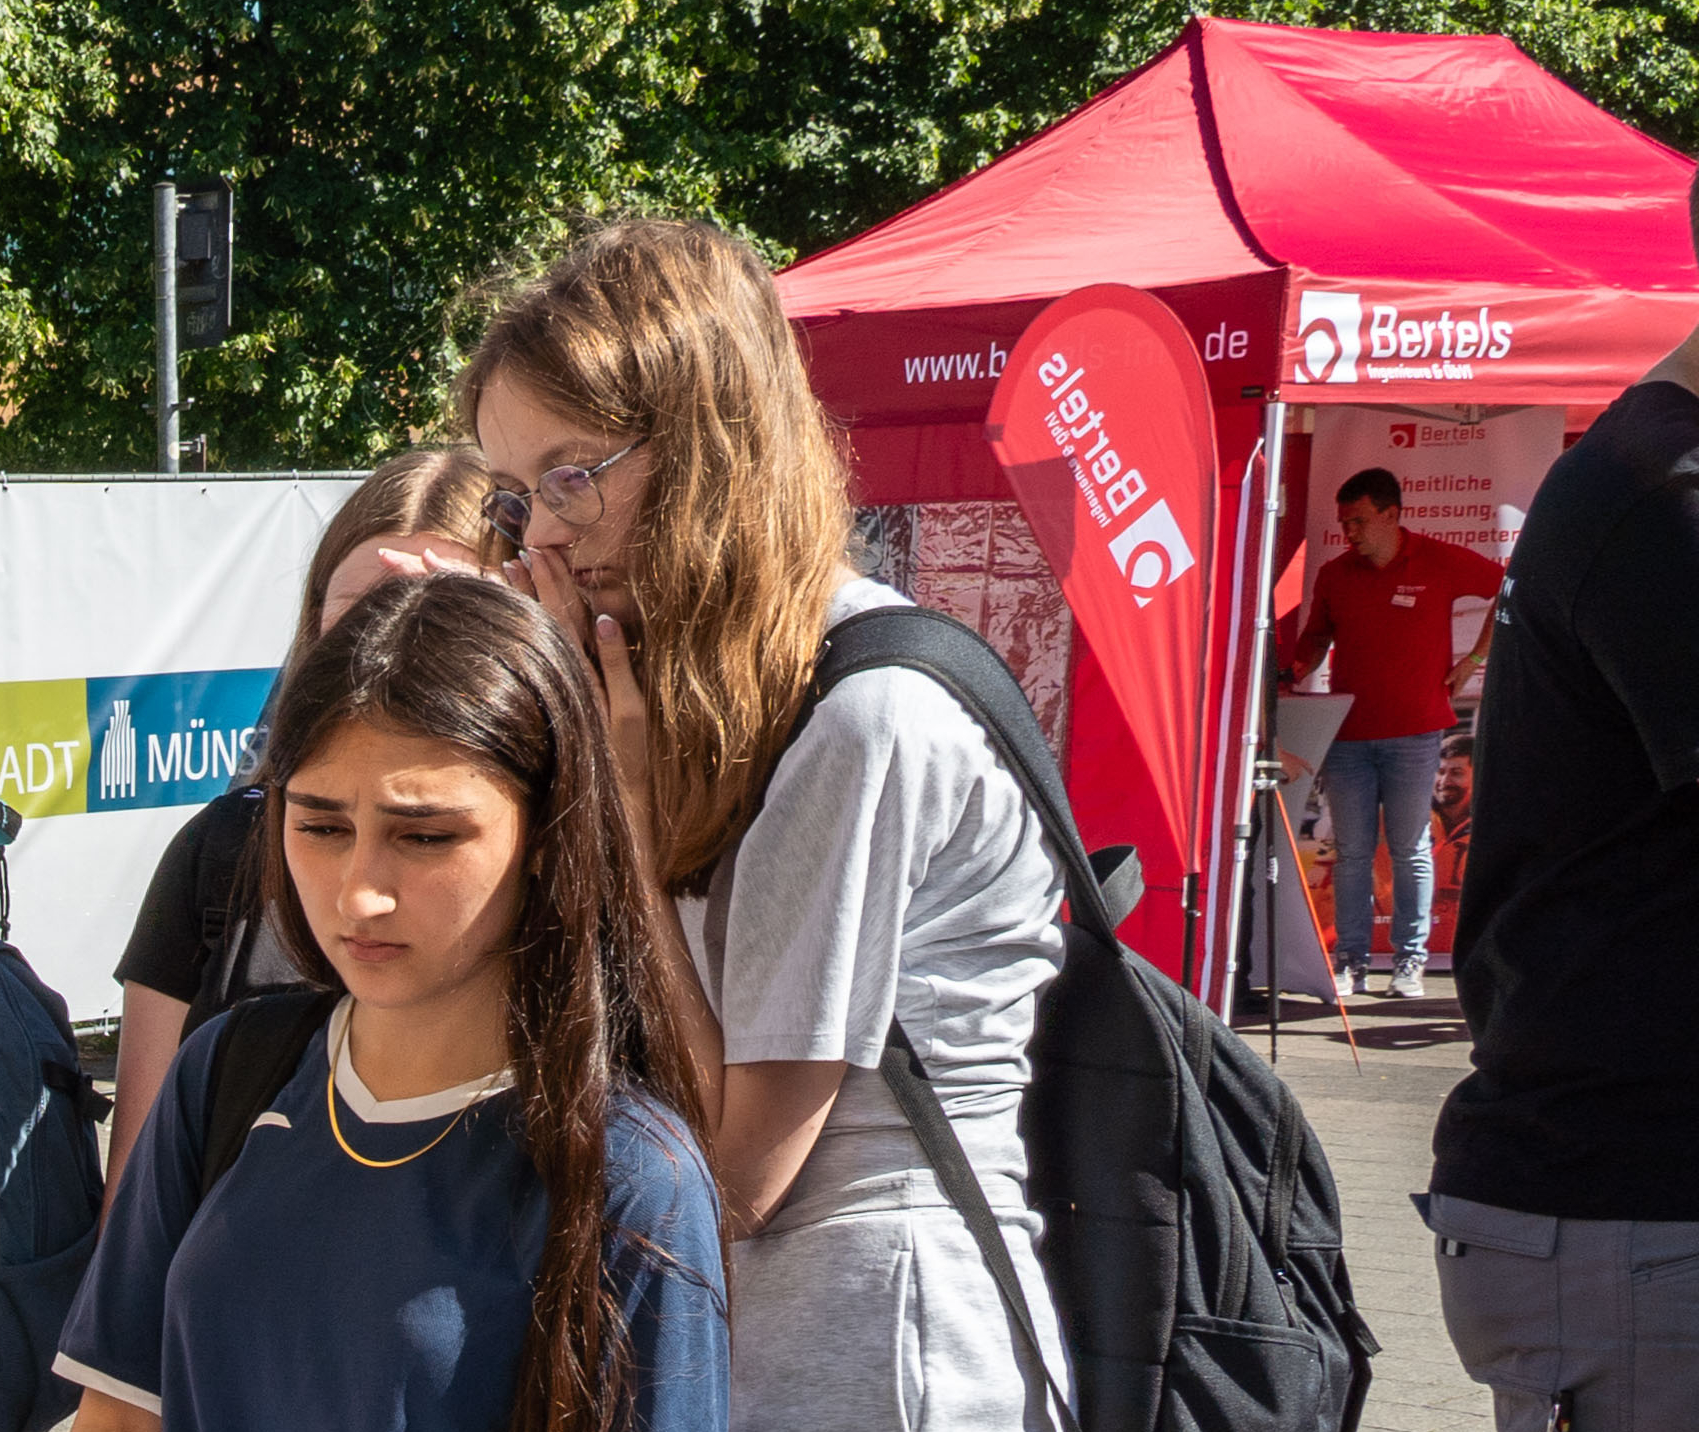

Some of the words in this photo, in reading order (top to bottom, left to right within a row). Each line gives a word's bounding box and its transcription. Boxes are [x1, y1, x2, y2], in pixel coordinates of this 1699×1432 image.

[1369, 305, 1514, 359] Bertels
[904, 341, 1008, 386] www.b
[1420, 426, 1486, 441] Bertels
[1402, 474, 1492, 493] heitliche
[1401, 503, 1498, 521] messung,
[148, 718, 265, 784] MÜNS
